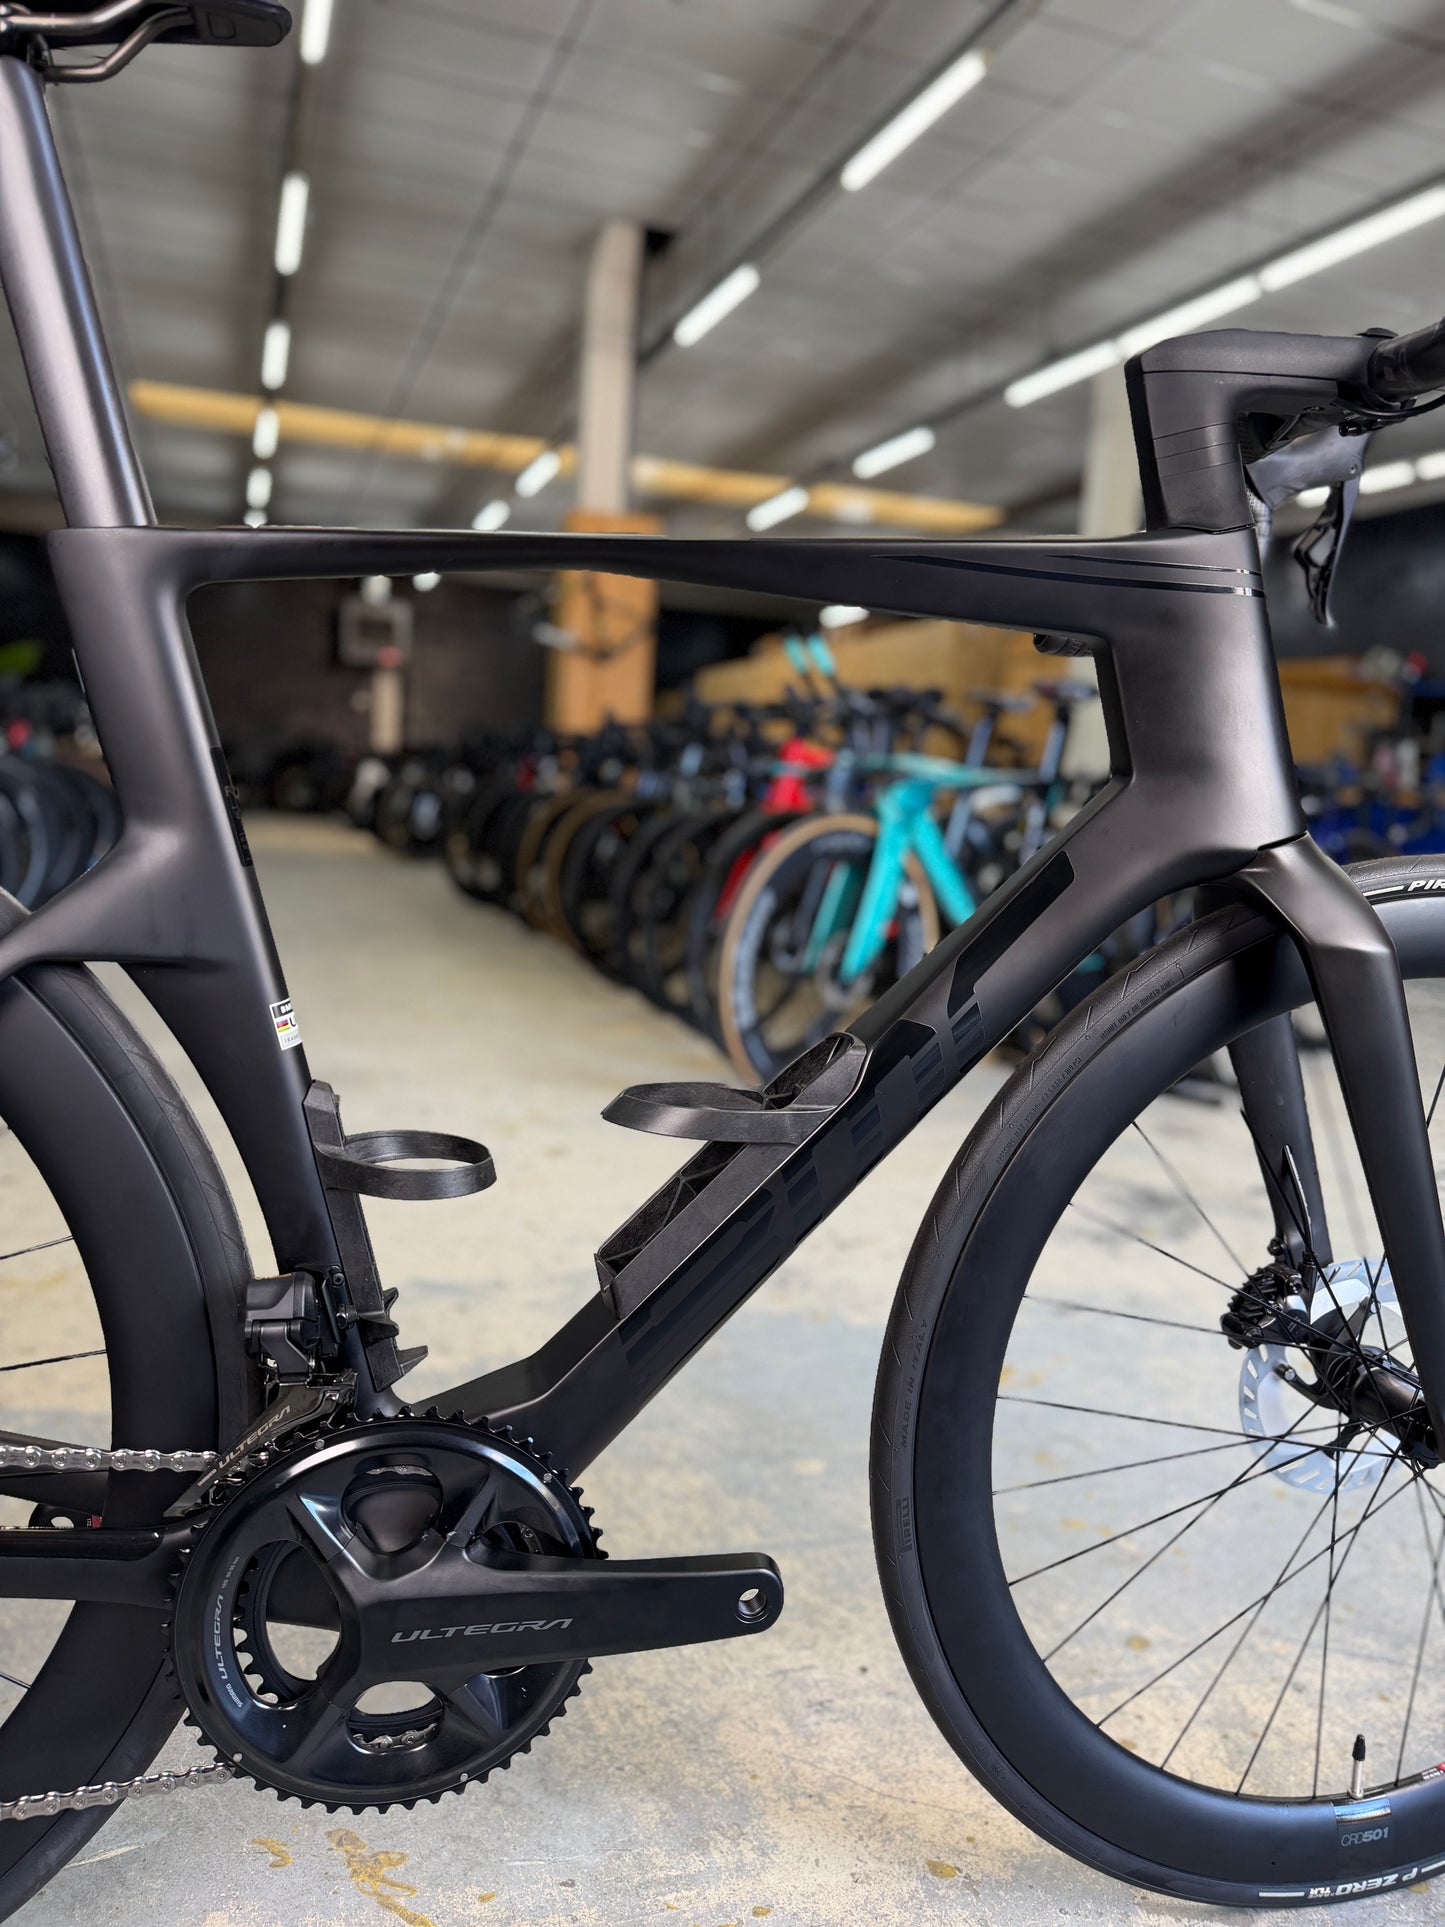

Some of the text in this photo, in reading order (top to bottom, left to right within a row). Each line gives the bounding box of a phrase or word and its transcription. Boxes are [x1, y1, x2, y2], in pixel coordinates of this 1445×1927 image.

[219, 1404, 291, 1470] ULTEGRA
[899, 1400, 913, 1447] MADE
[213, 1594, 227, 1679] ULTEGRA
[391, 1618, 573, 1643] ULTEGRA
[1340, 1826, 1389, 1846] CRD501
[1309, 1886, 1330, 1894] TLR
[1335, 1867, 1419, 1895] P ZERO
